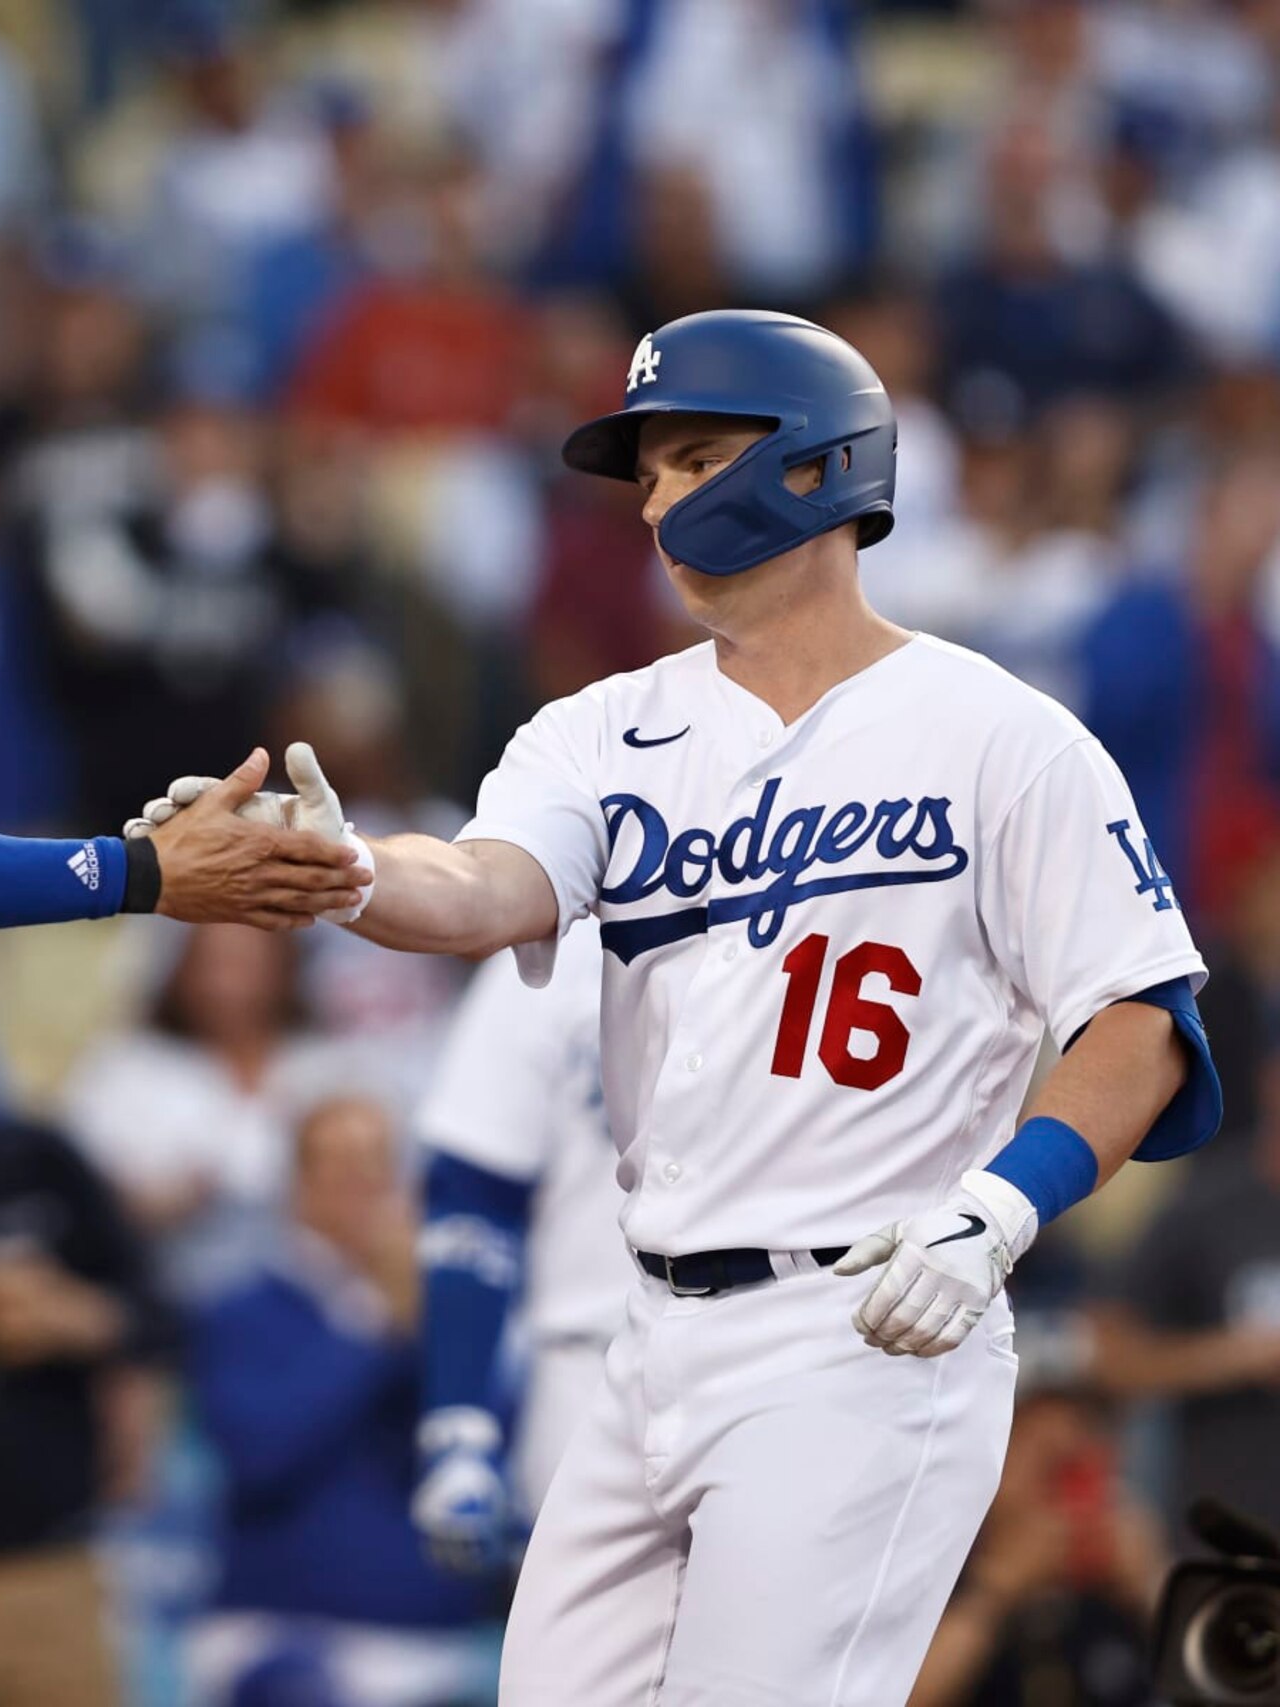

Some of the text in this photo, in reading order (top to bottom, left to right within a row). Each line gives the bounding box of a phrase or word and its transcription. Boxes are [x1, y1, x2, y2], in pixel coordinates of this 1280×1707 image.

[83, 842, 100, 890] adidas
[600, 777, 969, 950] Dodgers
[771, 933, 922, 1091] 16
